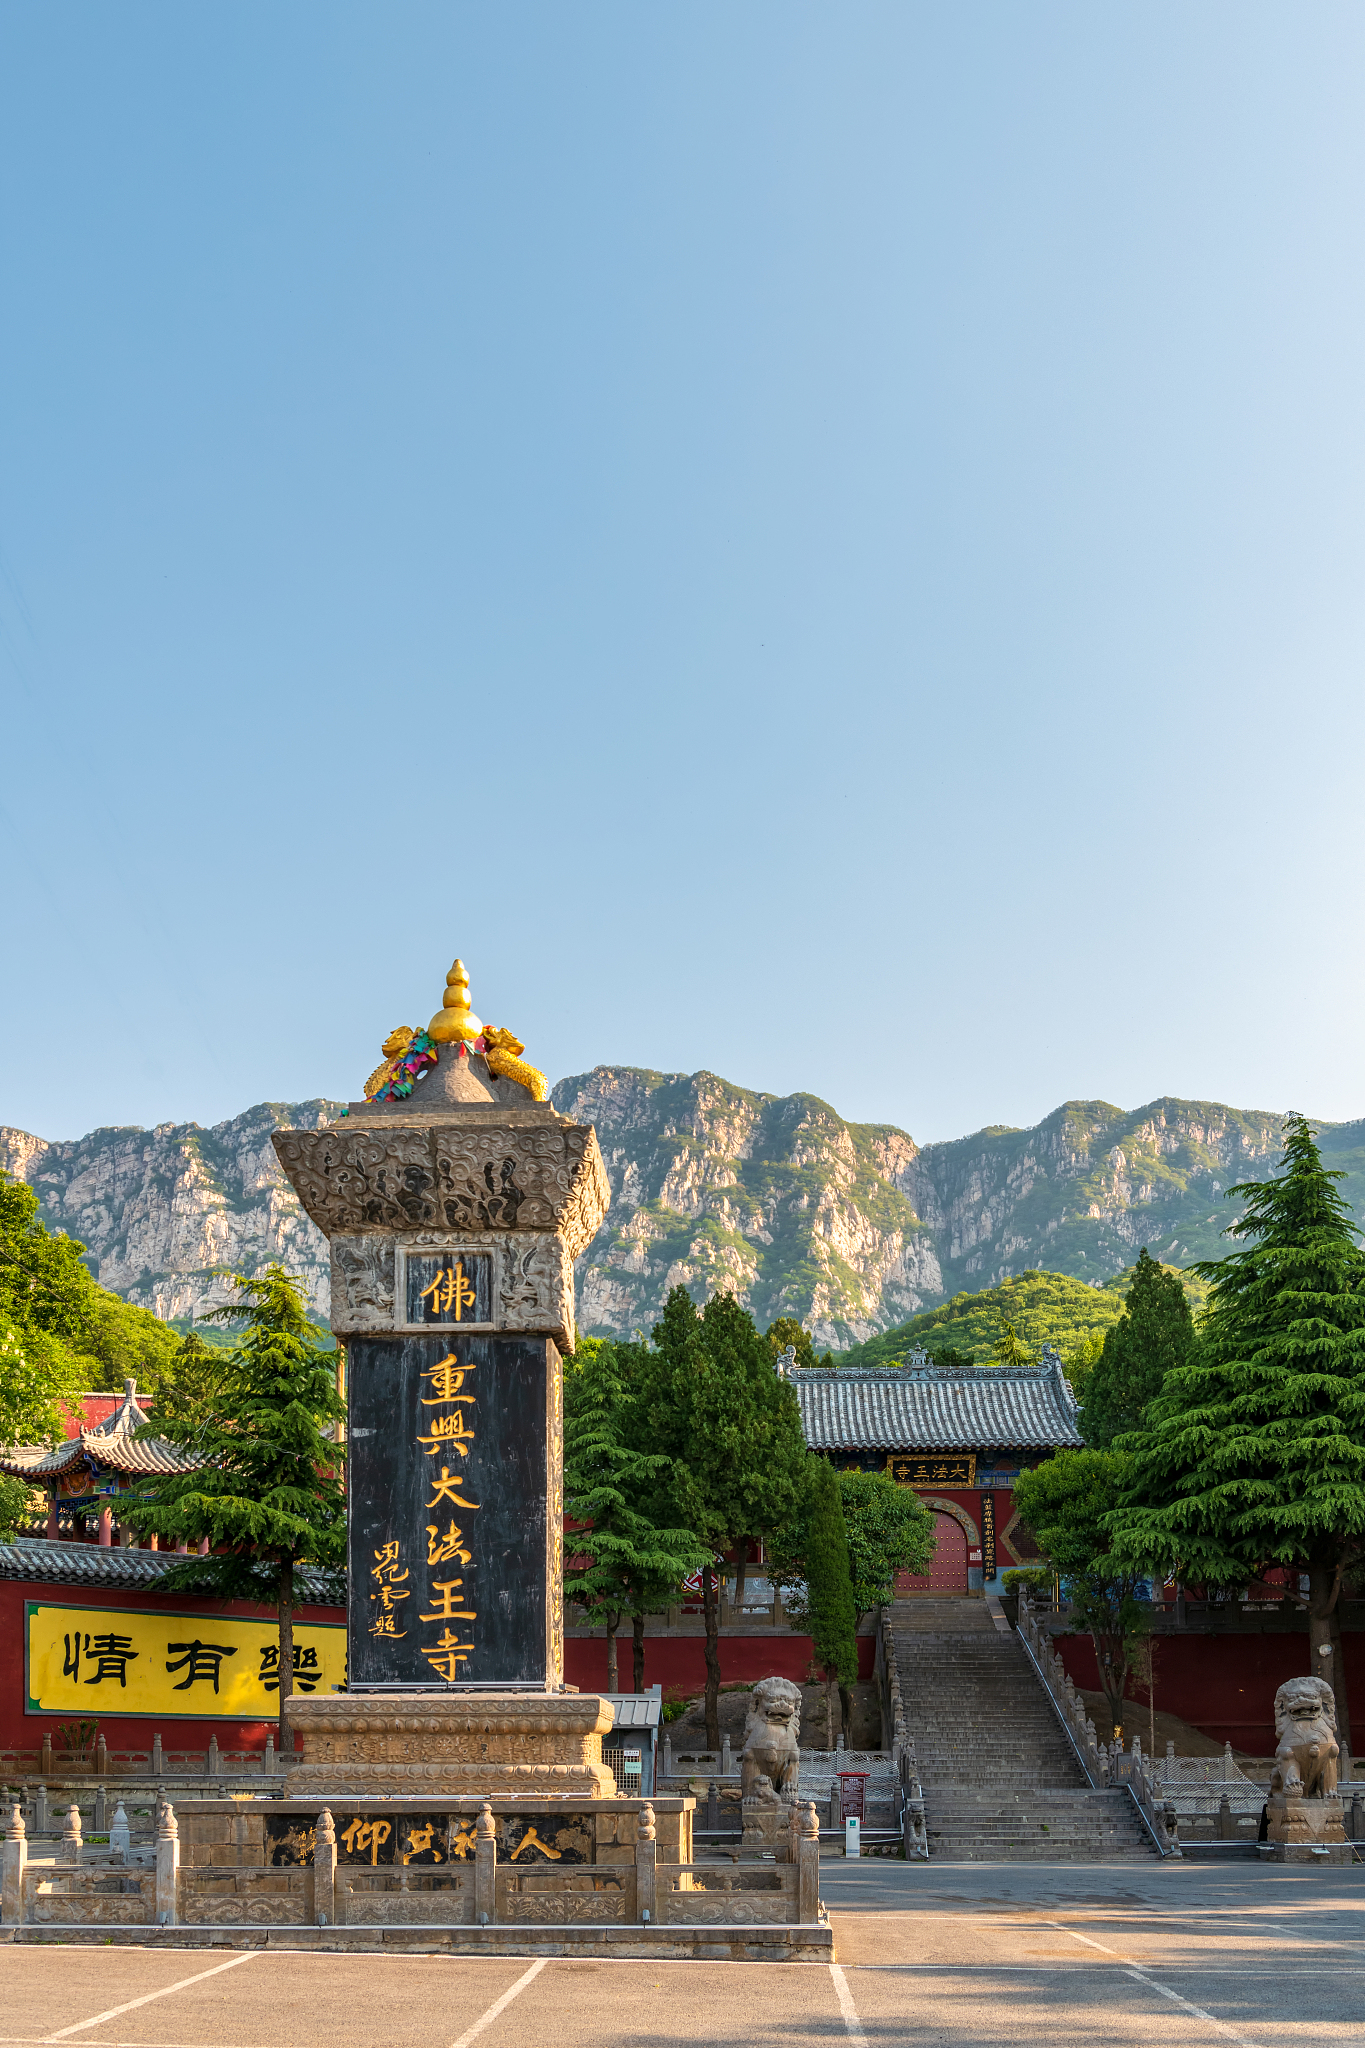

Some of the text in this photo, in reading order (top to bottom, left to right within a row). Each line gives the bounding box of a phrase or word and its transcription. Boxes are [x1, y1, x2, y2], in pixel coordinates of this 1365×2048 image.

[419, 1261, 477, 1321] 佛
[62, 1631, 347, 1694] 樂有情
